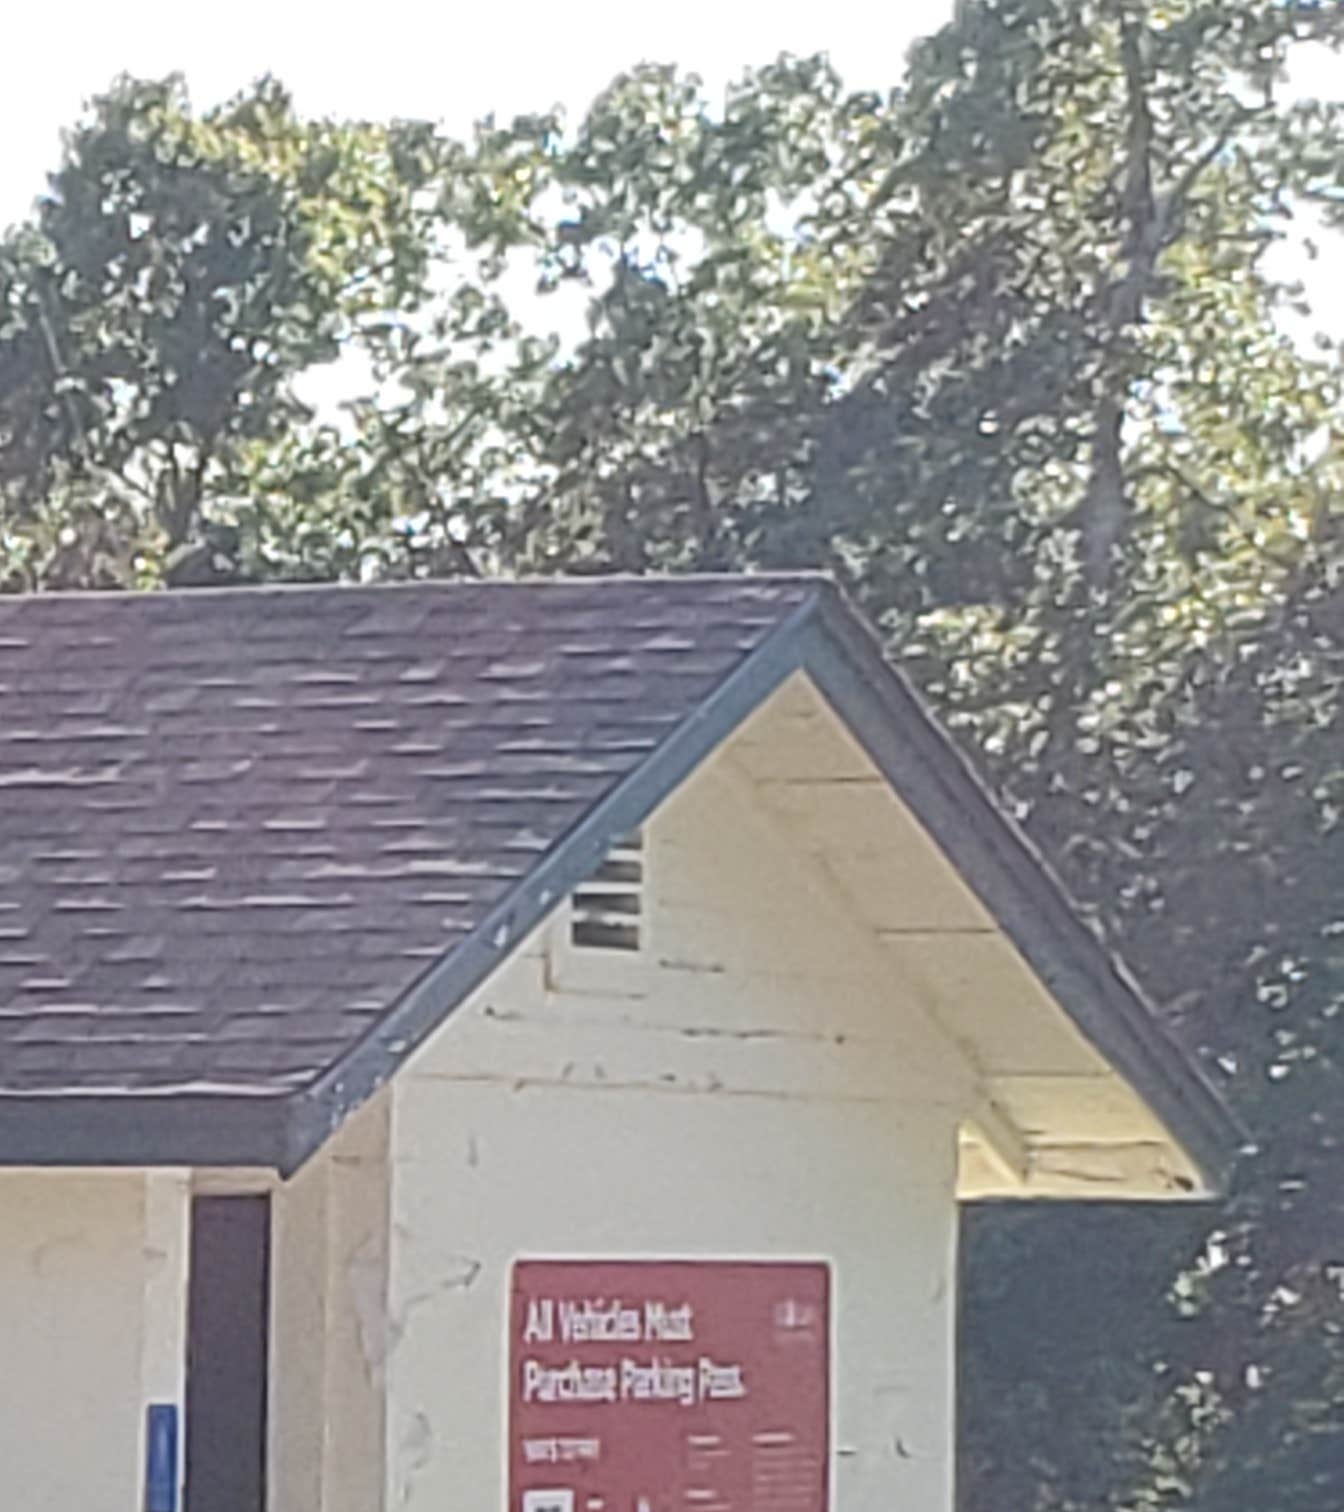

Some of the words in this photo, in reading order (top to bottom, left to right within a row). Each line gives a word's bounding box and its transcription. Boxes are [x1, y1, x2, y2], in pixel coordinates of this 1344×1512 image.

[524, 1299, 553, 1342] All
[559, 1298, 640, 1342] Vehicles
[644, 1300, 694, 1341] Must
[523, 1358, 616, 1402] Purchase
[620, 1356, 695, 1405] Parking
